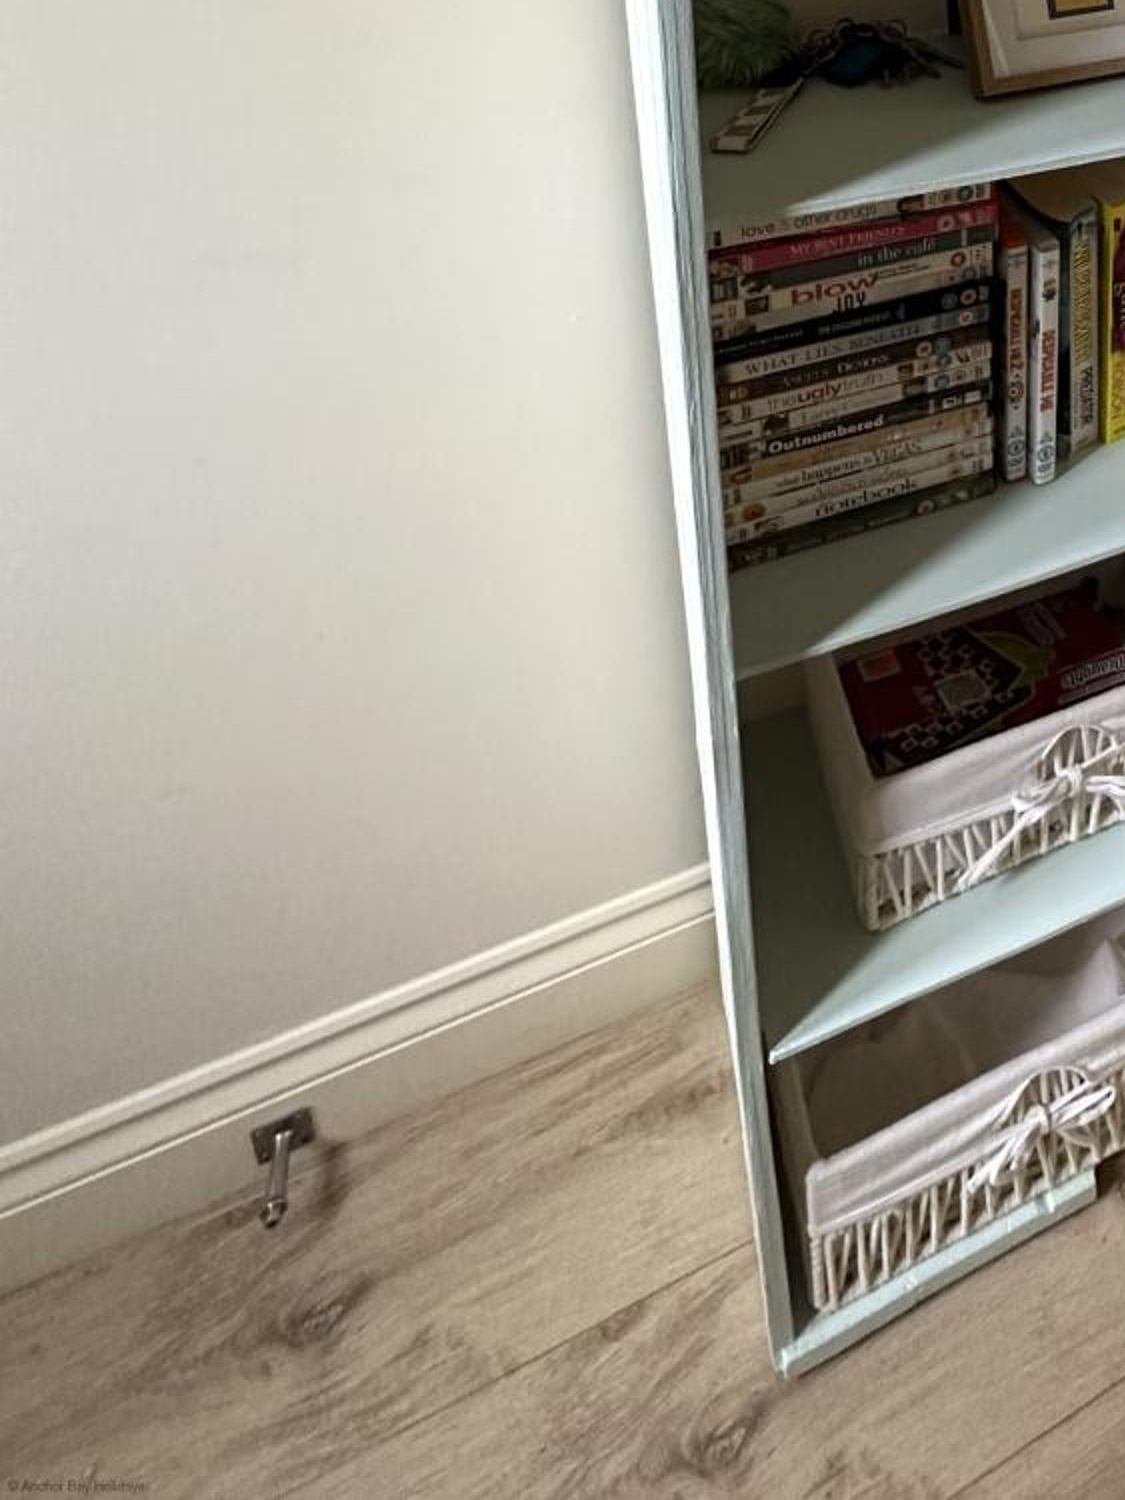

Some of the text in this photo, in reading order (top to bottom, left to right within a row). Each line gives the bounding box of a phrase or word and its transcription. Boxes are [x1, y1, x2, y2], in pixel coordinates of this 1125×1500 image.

[740, 222, 774, 238] love
[790, 274, 879, 306] blow
[832, 292, 866, 314] JOY
[746, 354, 799, 376] WHAT
[797, 382, 841, 405] ugly
[767, 414, 885, 453] Outnumbered
[814, 478, 918, 517] notebook
